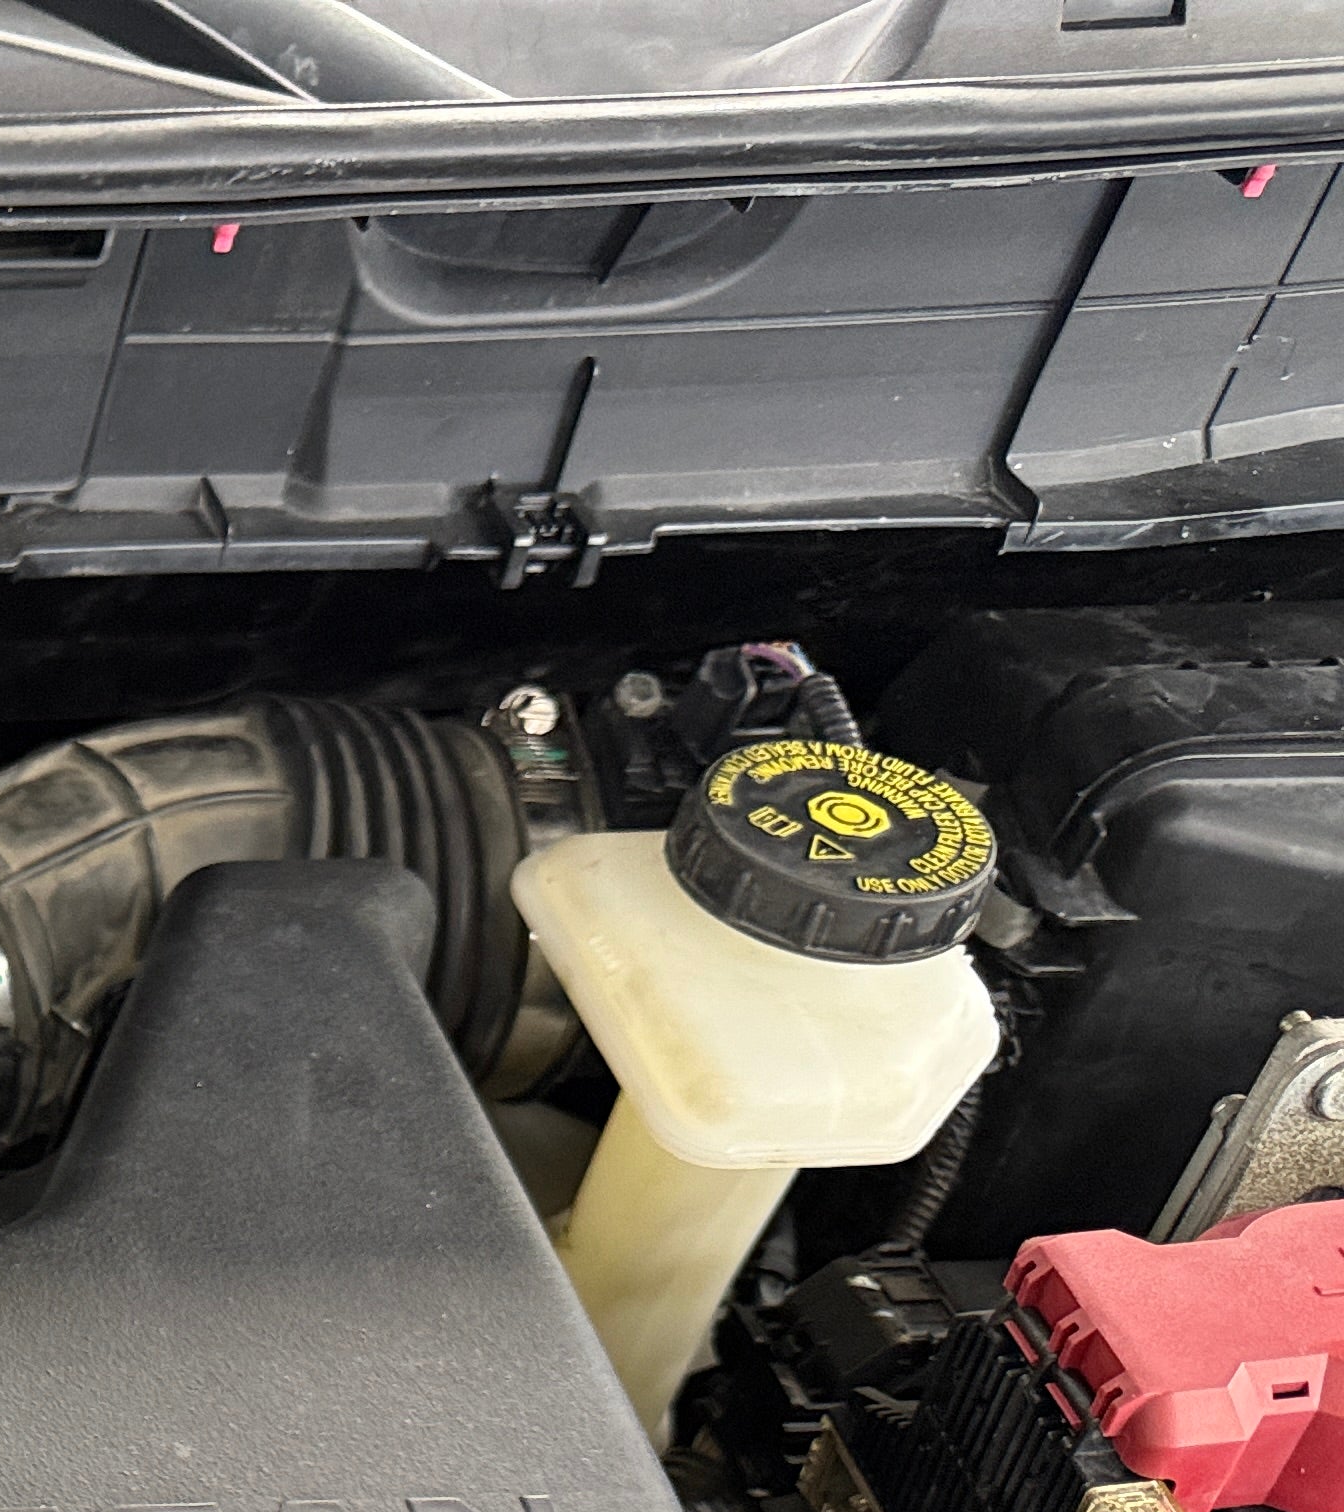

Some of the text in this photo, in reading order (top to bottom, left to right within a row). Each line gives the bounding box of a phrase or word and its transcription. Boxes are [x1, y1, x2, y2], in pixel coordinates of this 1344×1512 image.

[808, 740, 822, 755] A
[825, 743, 882, 766] FROM
[881, 756, 936, 786] FLUID
[847, 773, 929, 820] WARNING
[927, 781, 980, 817] BRAKE
[746, 755, 963, 874] CLEAN FILLER CAP BEFORE REMOVING
[856, 876, 898, 894] USE
[897, 873, 946, 893] ONLY
